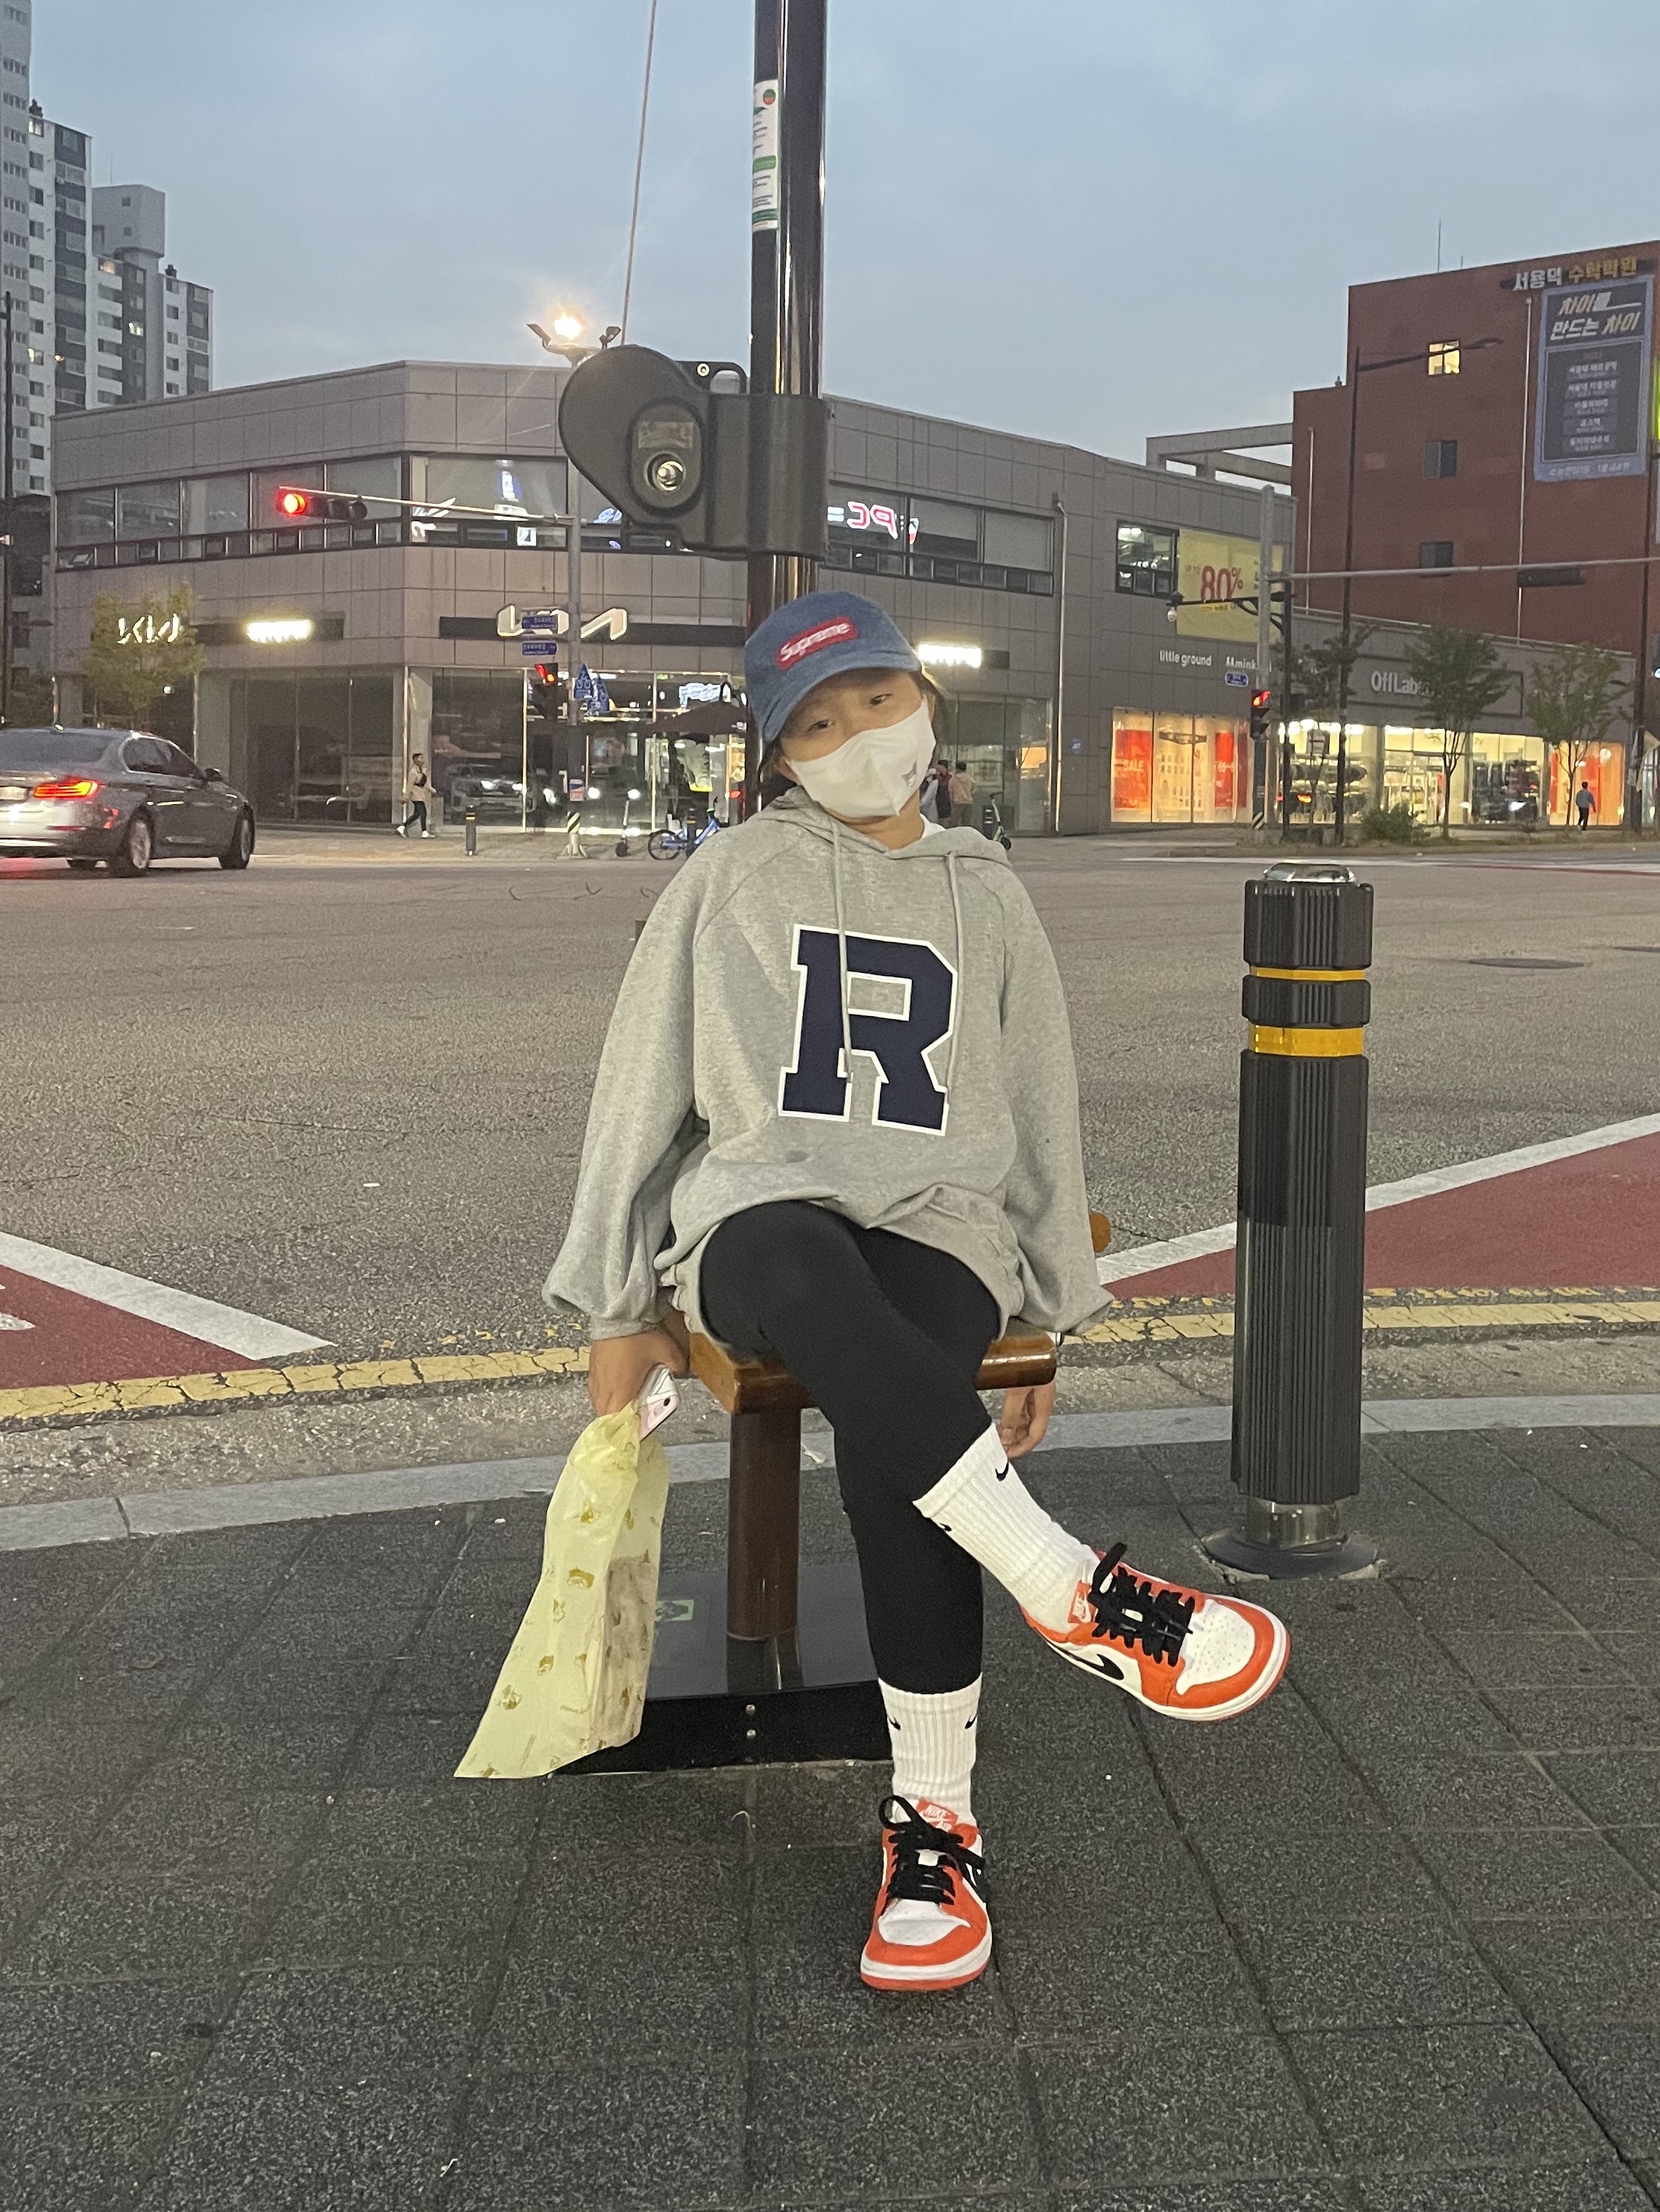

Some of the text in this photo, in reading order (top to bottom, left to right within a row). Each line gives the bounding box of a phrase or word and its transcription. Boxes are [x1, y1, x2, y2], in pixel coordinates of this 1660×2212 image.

[1201, 565, 1243, 601] 80%
[780, 622, 850, 662] Supreme
[1159, 649, 1179, 663] little
[1181, 653, 1212, 668] ground
[1123, 759, 1144, 772] SALE
[778, 923, 958, 1137] R
